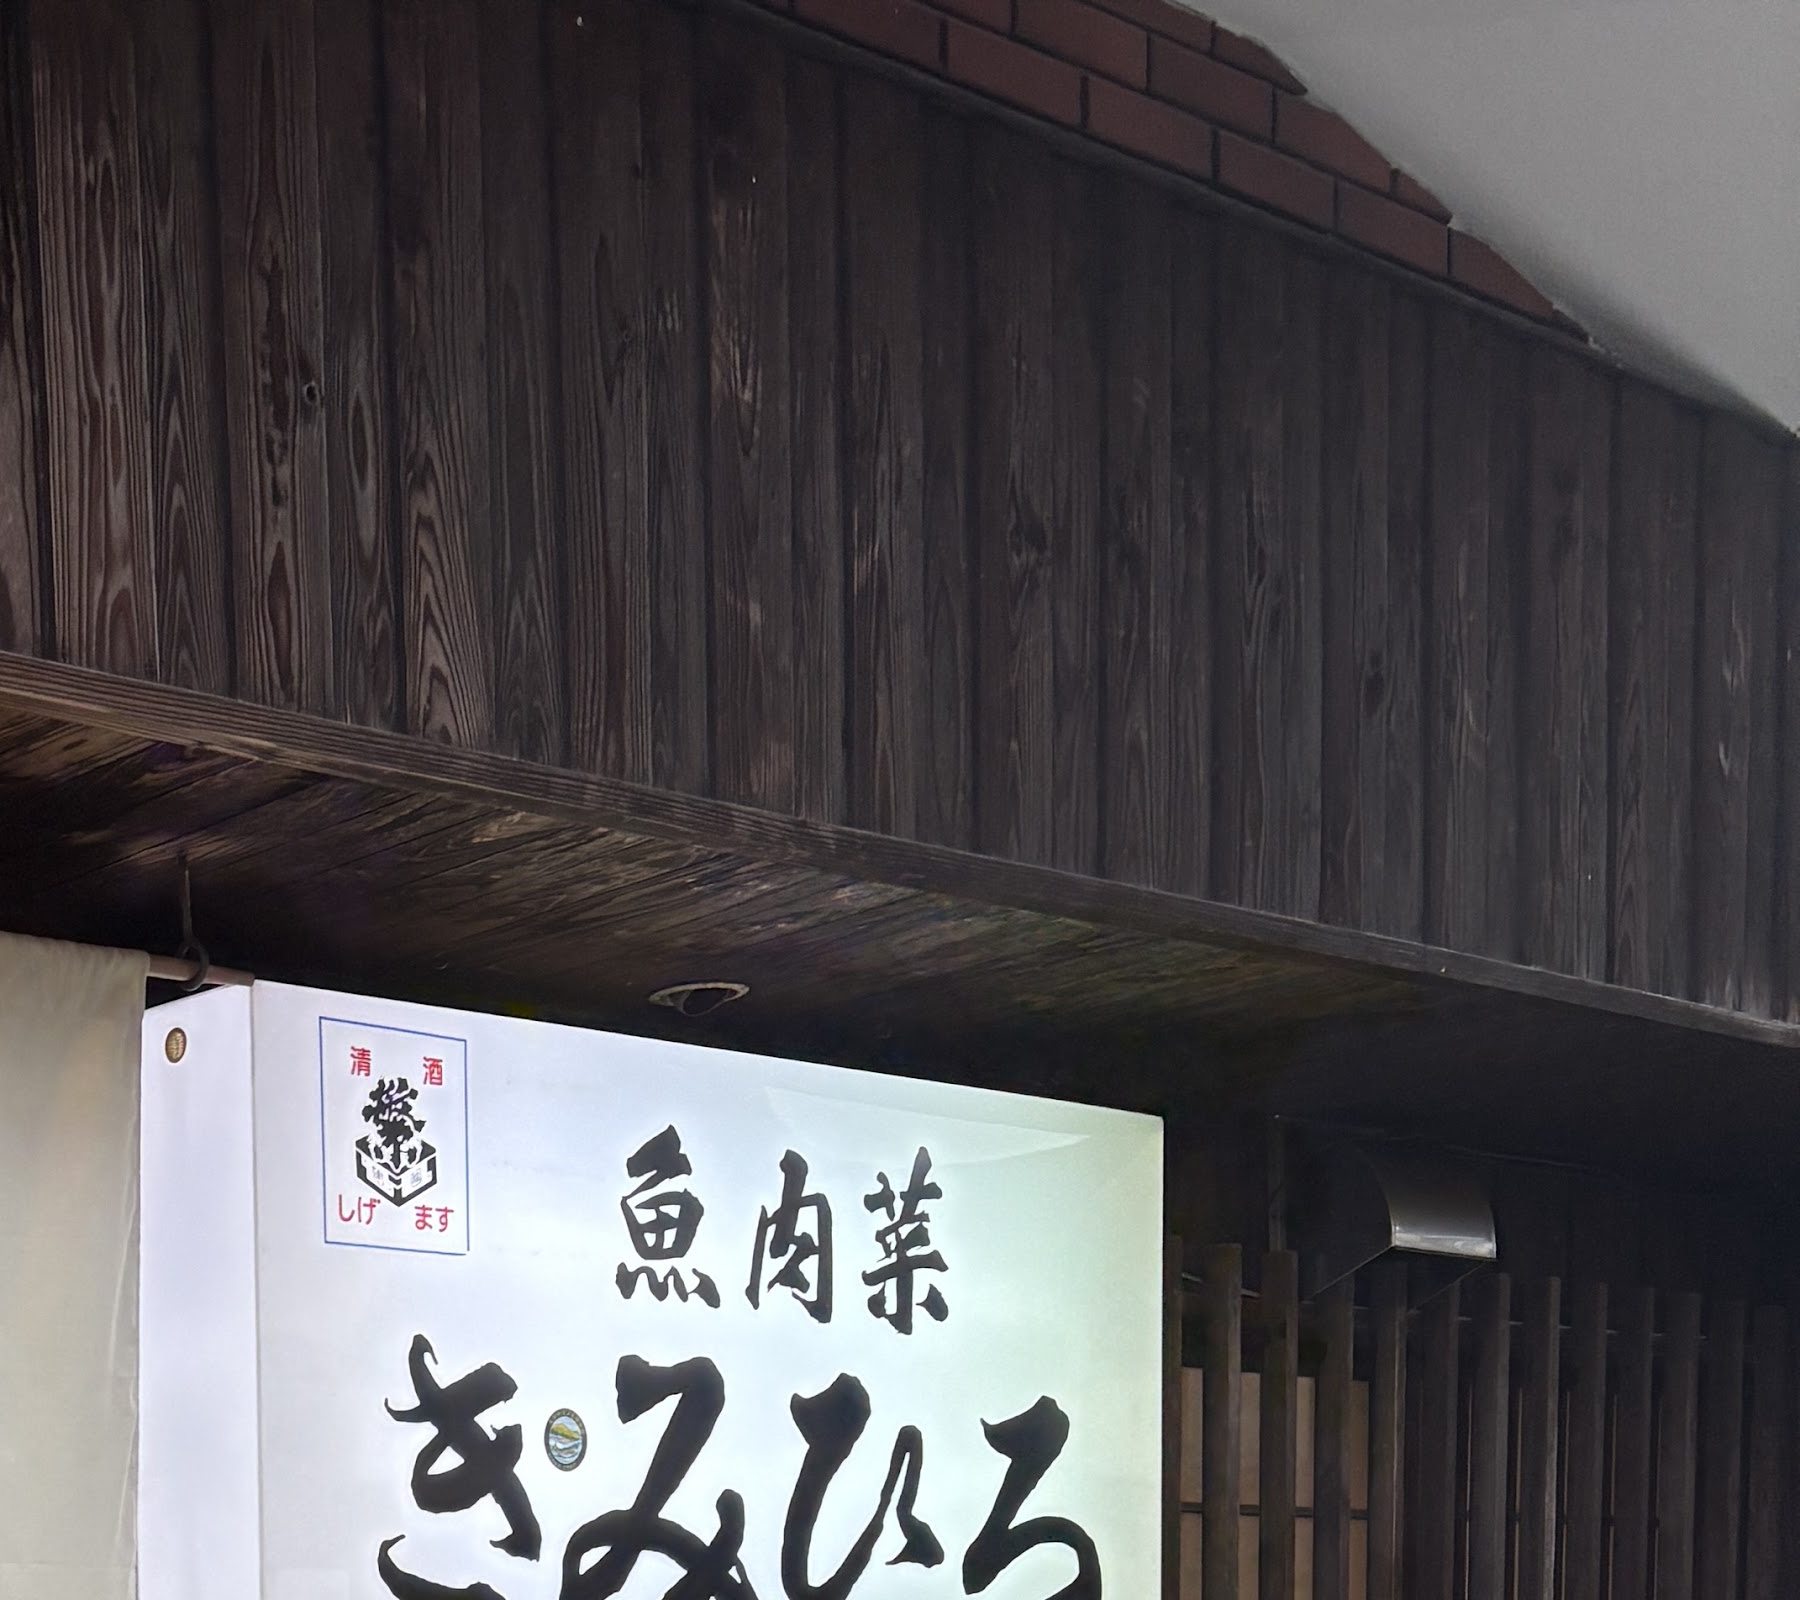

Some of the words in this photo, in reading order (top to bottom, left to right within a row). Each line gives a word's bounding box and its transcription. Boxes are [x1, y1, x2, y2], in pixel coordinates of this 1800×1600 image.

[350, 1045, 372, 1077] 清
[423, 1056, 443, 1086] 酒
[338, 1194, 381, 1225] しげ
[415, 1204, 454, 1233] ます
[615, 1124, 949, 1335] 魚肉菜
